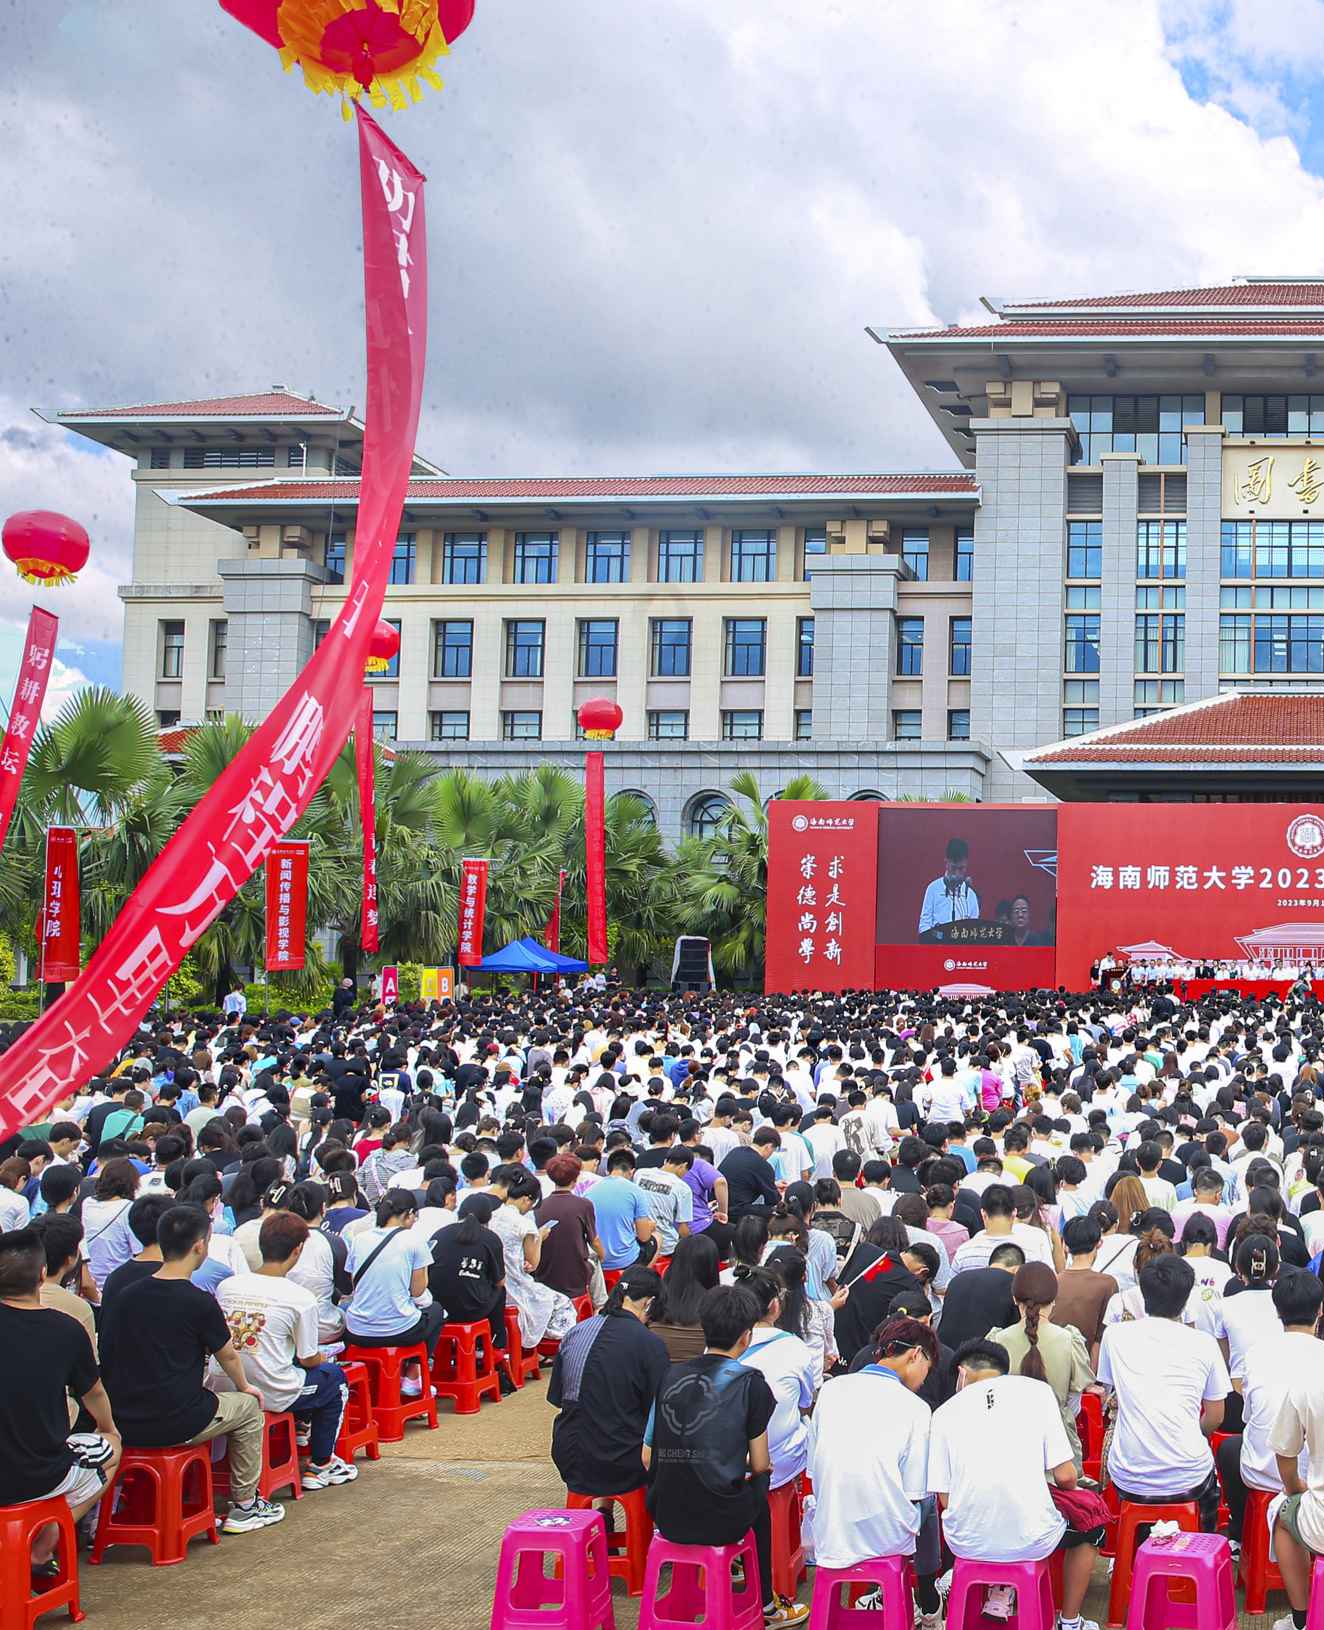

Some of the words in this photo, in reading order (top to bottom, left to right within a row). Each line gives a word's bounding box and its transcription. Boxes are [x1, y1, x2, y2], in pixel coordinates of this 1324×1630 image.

[1, 644, 50, 775] 躬耕教坛
[0, 690, 324, 1132] 鹏程万里奋
[278, 859, 292, 961] 新闻传播与影视学院
[460, 873, 477, 953] 数学与统计学院
